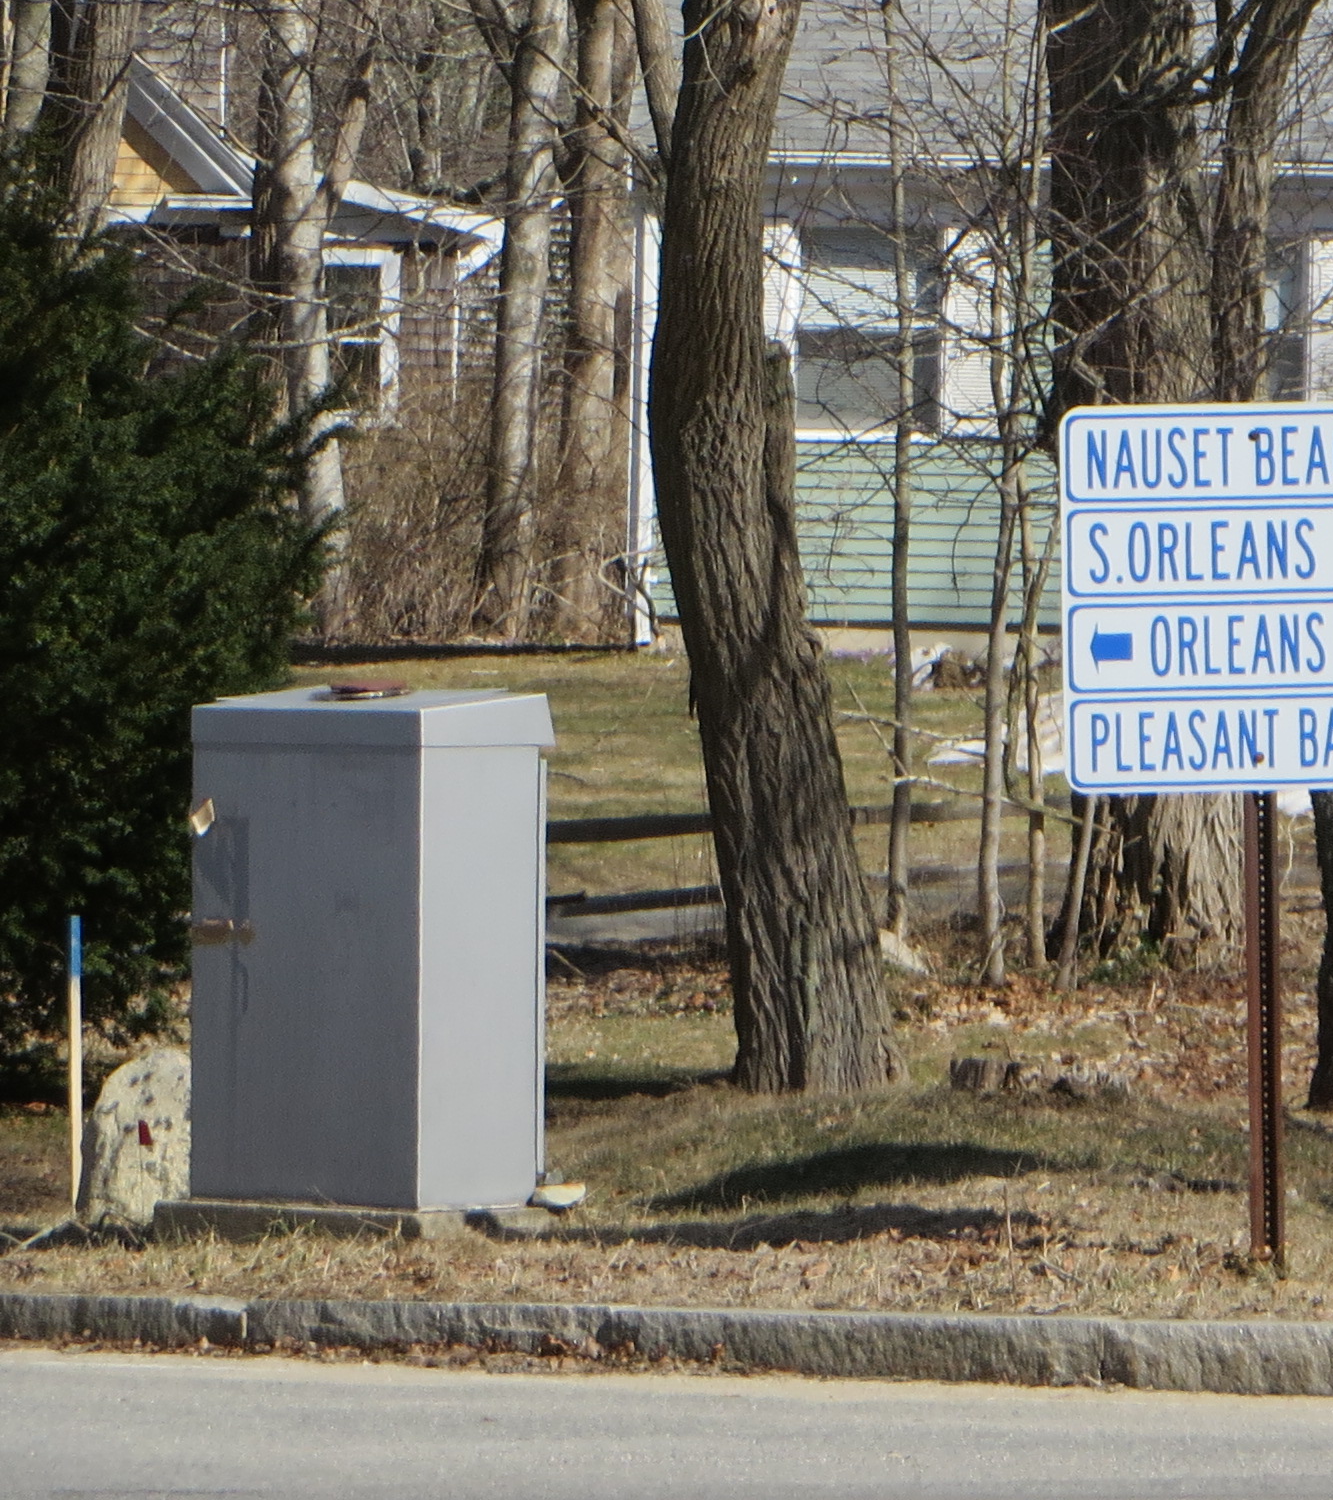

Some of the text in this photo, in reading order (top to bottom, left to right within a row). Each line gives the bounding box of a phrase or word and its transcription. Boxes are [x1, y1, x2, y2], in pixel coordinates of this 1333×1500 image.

[1086, 426, 1234, 490] NAUSET
[1149, 611, 1327, 678] ORLEANS
[1090, 707, 1280, 773] PLEASANT
